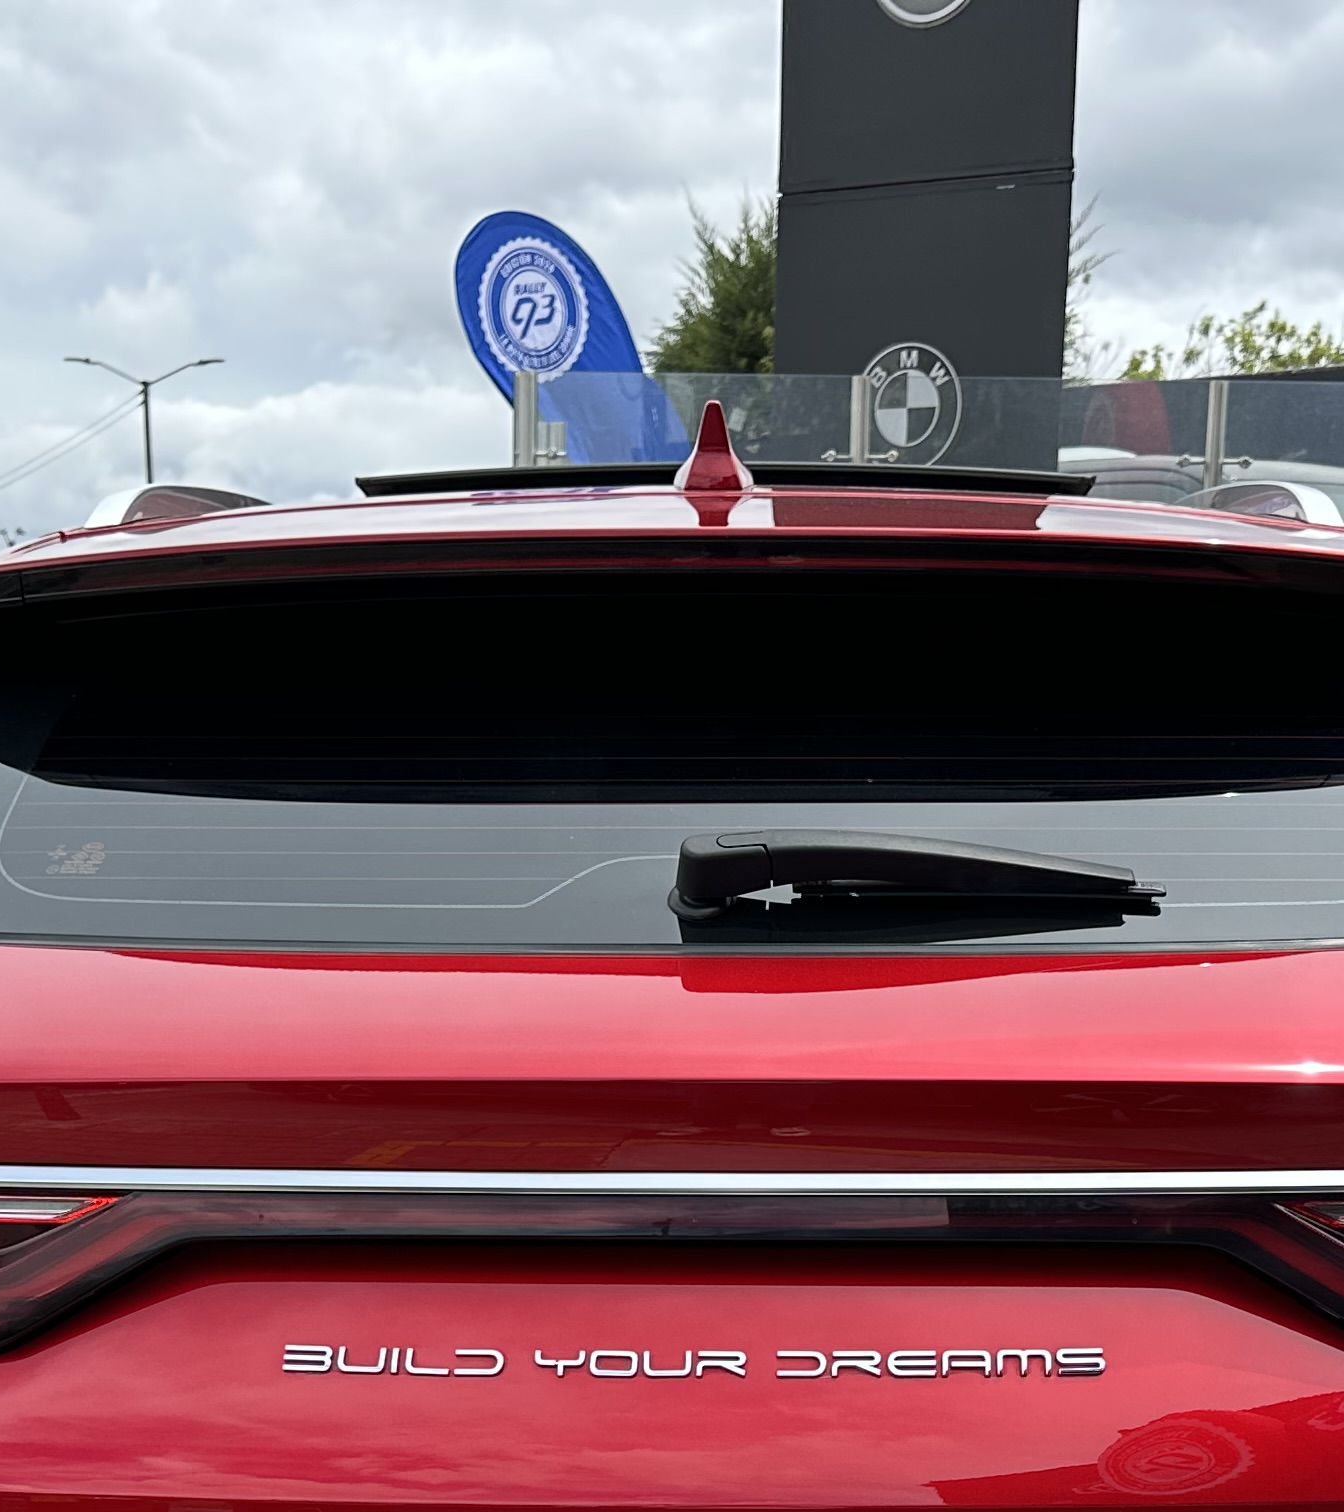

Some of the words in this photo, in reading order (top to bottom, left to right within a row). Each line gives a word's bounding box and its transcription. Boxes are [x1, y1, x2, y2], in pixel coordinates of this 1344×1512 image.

[511, 294, 555, 340] 93
[869, 349, 951, 389] BMW
[282, 1344, 505, 1376] BUILD
[534, 1348, 748, 1377] YOUR
[775, 1347, 1107, 1378] DREAMS
